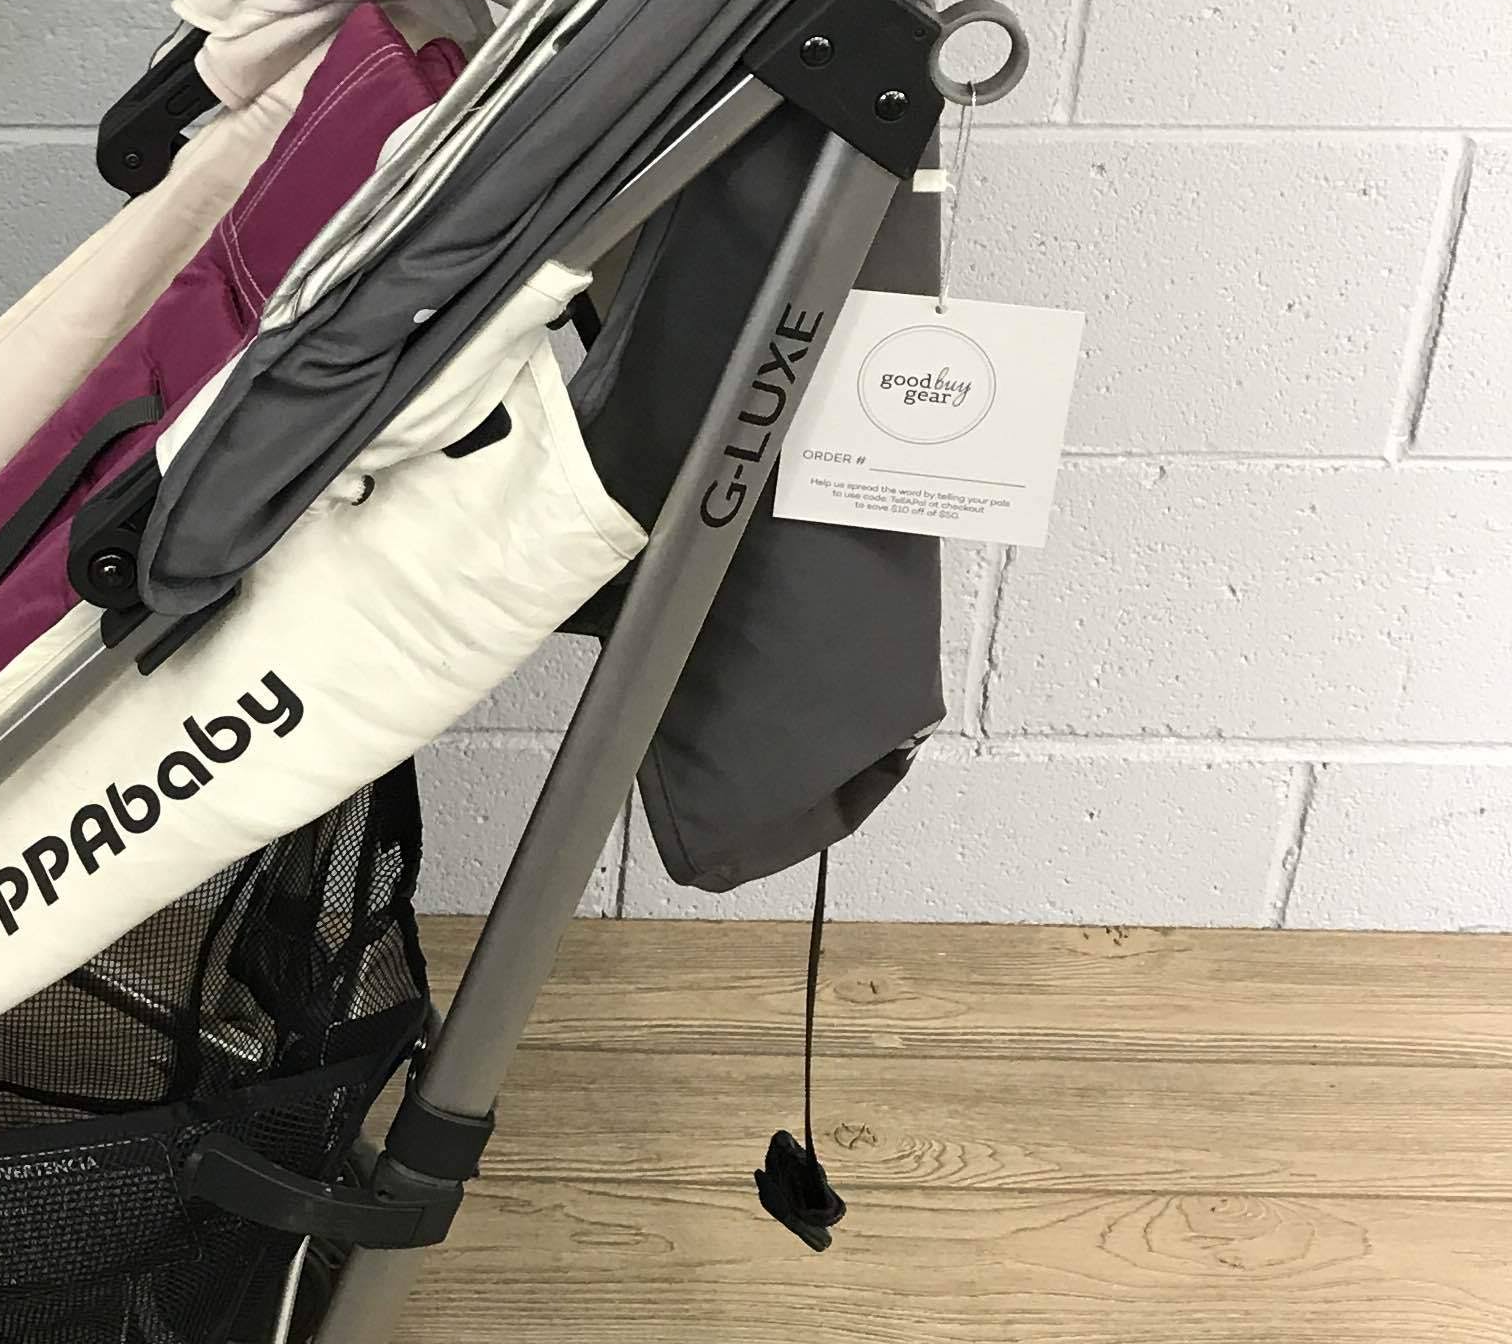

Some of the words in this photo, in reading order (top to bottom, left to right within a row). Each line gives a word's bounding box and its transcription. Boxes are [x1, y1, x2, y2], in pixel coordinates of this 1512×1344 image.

[903, 389, 952, 405] gear
[700, 302, 825, 528] G-LUXE
[802, 449, 852, 464] ORDER
[856, 455, 866, 465] #
[810, 477, 832, 488] Help
[833, 481, 845, 489] us
[847, 482, 879, 493] spread
[881, 484, 897, 494] the
[898, 489, 922, 497] word
[924, 490, 935, 500] by
[937, 492, 965, 504] telling
[968, 496, 989, 505] your
[990, 499, 1011, 508] pals
[832, 489, 843, 497] to
[844, 491, 861, 499] use
[941, 502, 985, 513] checkout
[855, 501, 865, 509] to
[866, 503, 889, 512] save
[891, 504, 910, 514] $10
[911, 507, 925, 516] off
[926, 509, 937, 517] of
